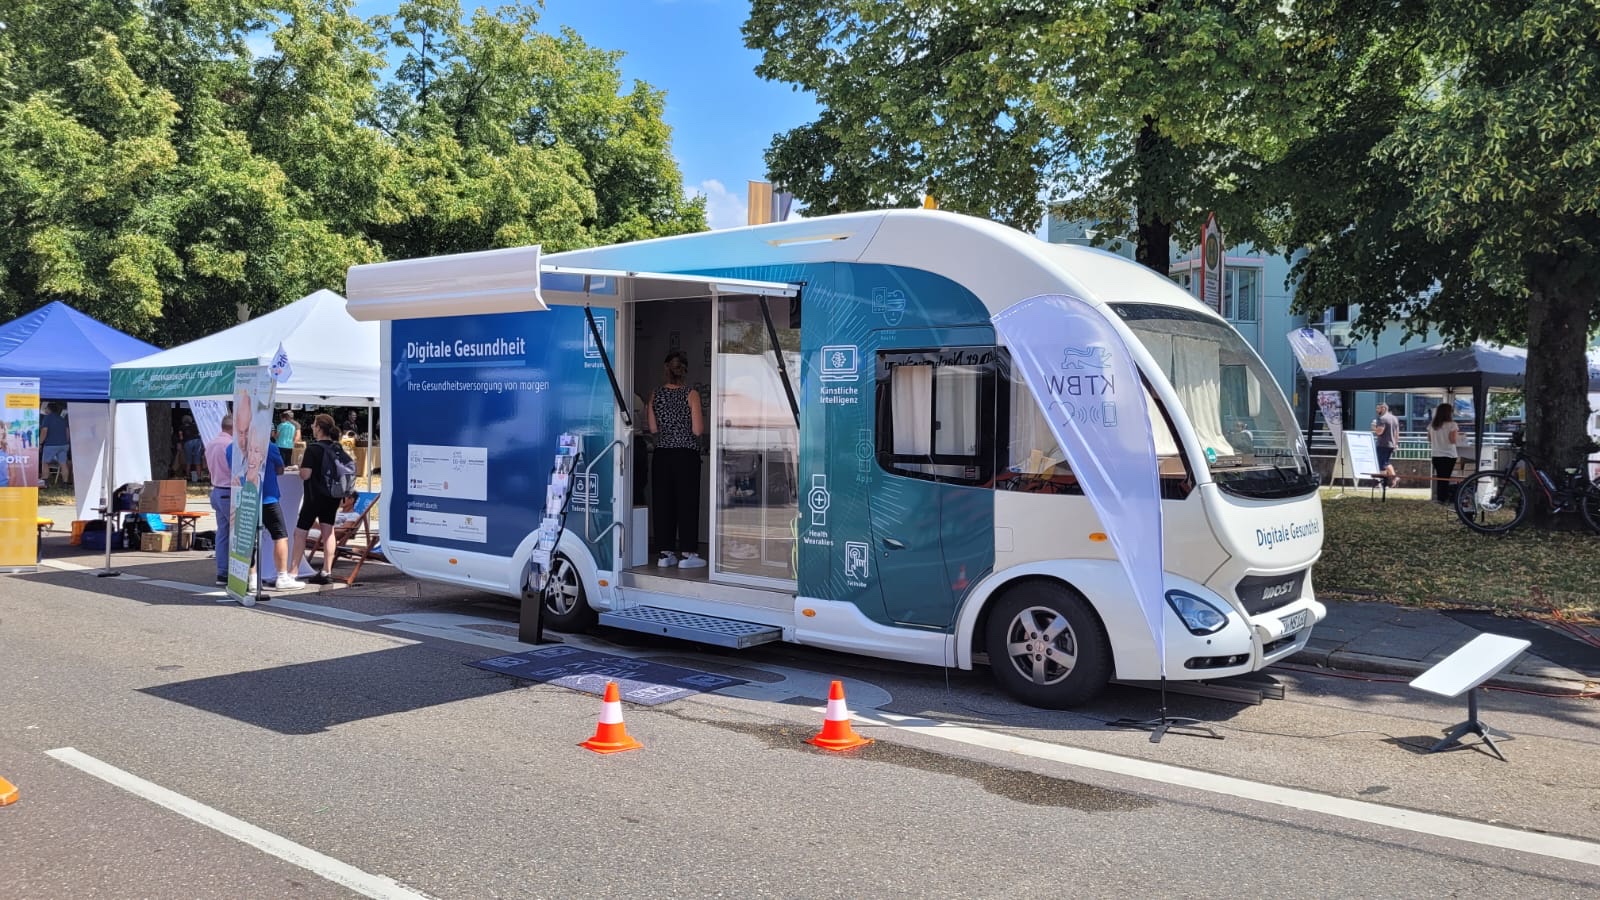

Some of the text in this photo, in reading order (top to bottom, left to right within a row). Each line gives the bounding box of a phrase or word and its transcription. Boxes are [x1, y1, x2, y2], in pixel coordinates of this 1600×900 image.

[407, 337, 526, 363] Digitale Gesundheit
[407, 380, 550, 394] Ihre Gesundheitsversorgung von morgen
[820, 386, 858, 395] Künstliche
[820, 396, 858, 406] Intelligenz
[808, 530, 828, 538] Health
[1256, 525, 1290, 550] Digitale
[803, 537, 834, 546] Wearables
